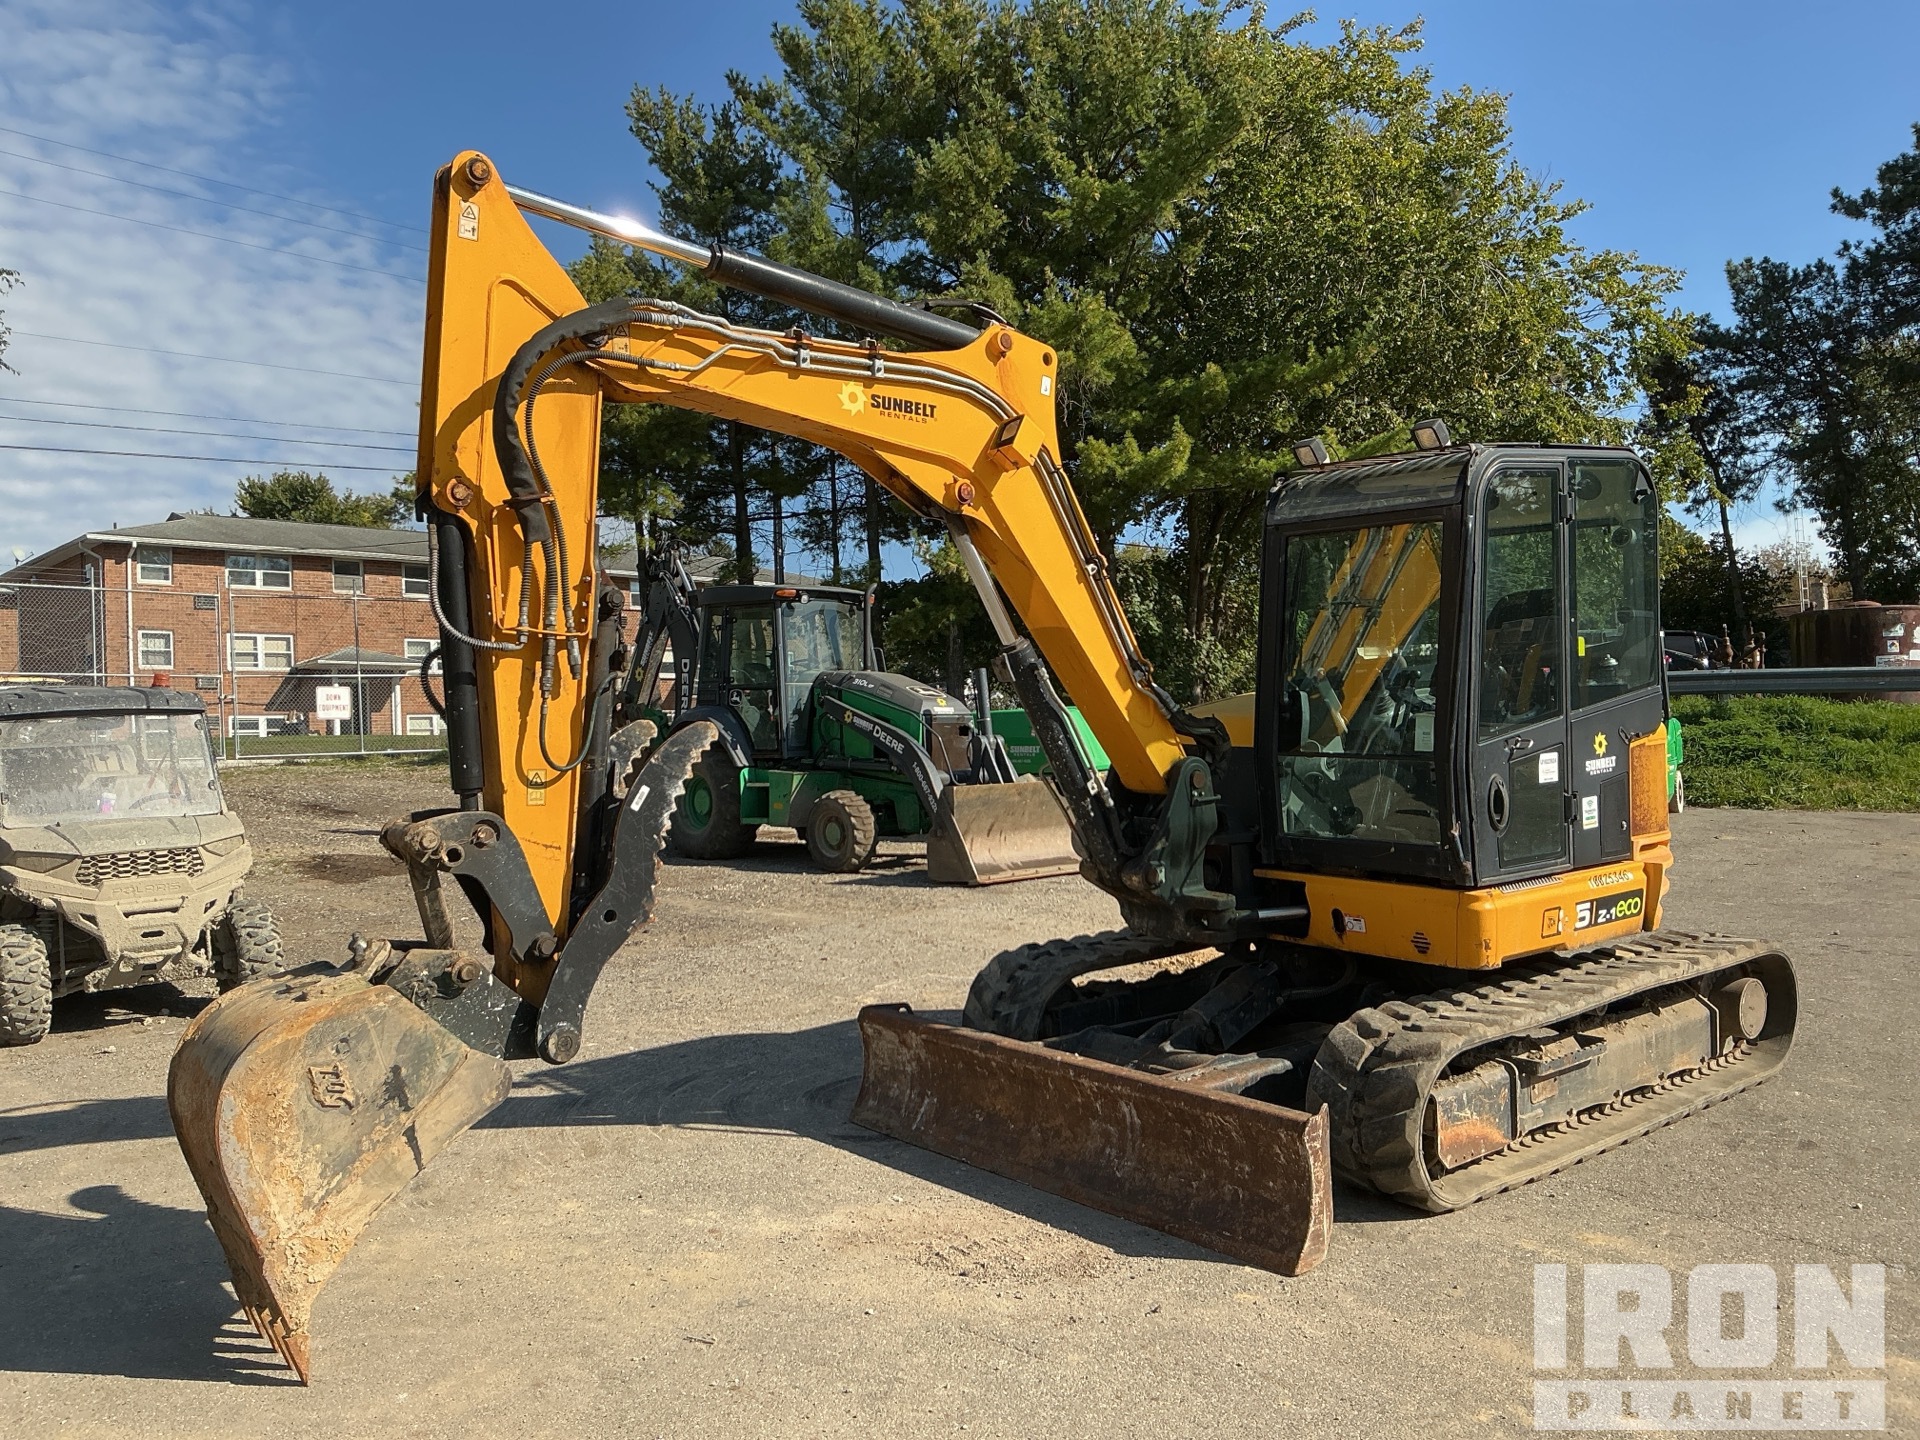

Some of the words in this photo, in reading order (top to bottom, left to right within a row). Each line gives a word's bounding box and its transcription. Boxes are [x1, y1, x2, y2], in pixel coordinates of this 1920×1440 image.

[870, 393, 937, 418] SUNBELT
[879, 410, 927, 424] RENTALS
[326, 693, 341, 701] DOWN
[319, 704, 349, 712] EQUIPMENT
[873, 725, 905, 754] DEERE
[1010, 745, 1040, 753] SUNBELT
[1585, 755, 1617, 772] SUNBELT
[1590, 768, 1613, 776] RENTALS
[112, 881, 181, 898] POLARIS
